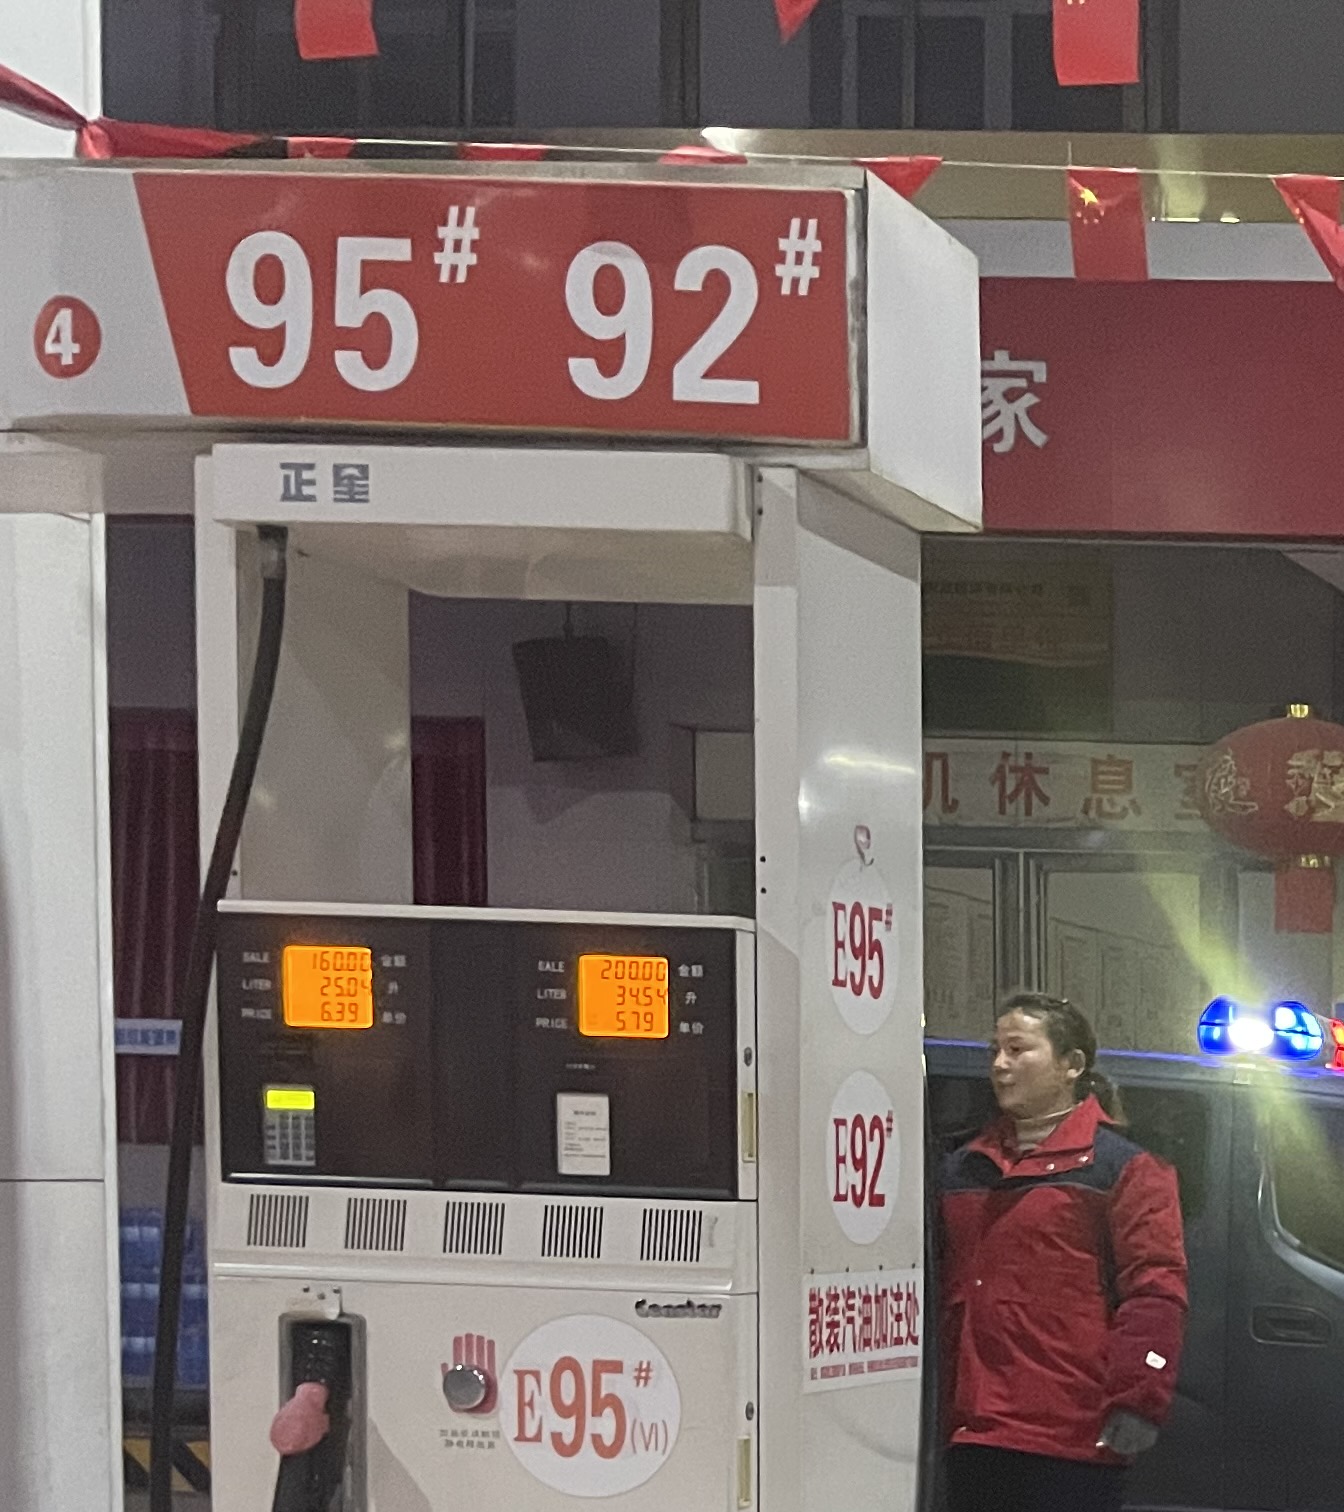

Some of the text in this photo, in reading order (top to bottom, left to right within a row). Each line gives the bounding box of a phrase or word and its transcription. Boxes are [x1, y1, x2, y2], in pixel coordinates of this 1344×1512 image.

[45, 309, 79, 365] 4
[225, 206, 822, 404] 95# 92#
[280, 462, 370, 503] 正星
[831, 901, 893, 1000] E95#
[831, 1109, 894, 1208] E92#
[808, 1281, 920, 1360] 散装汽油加注处
